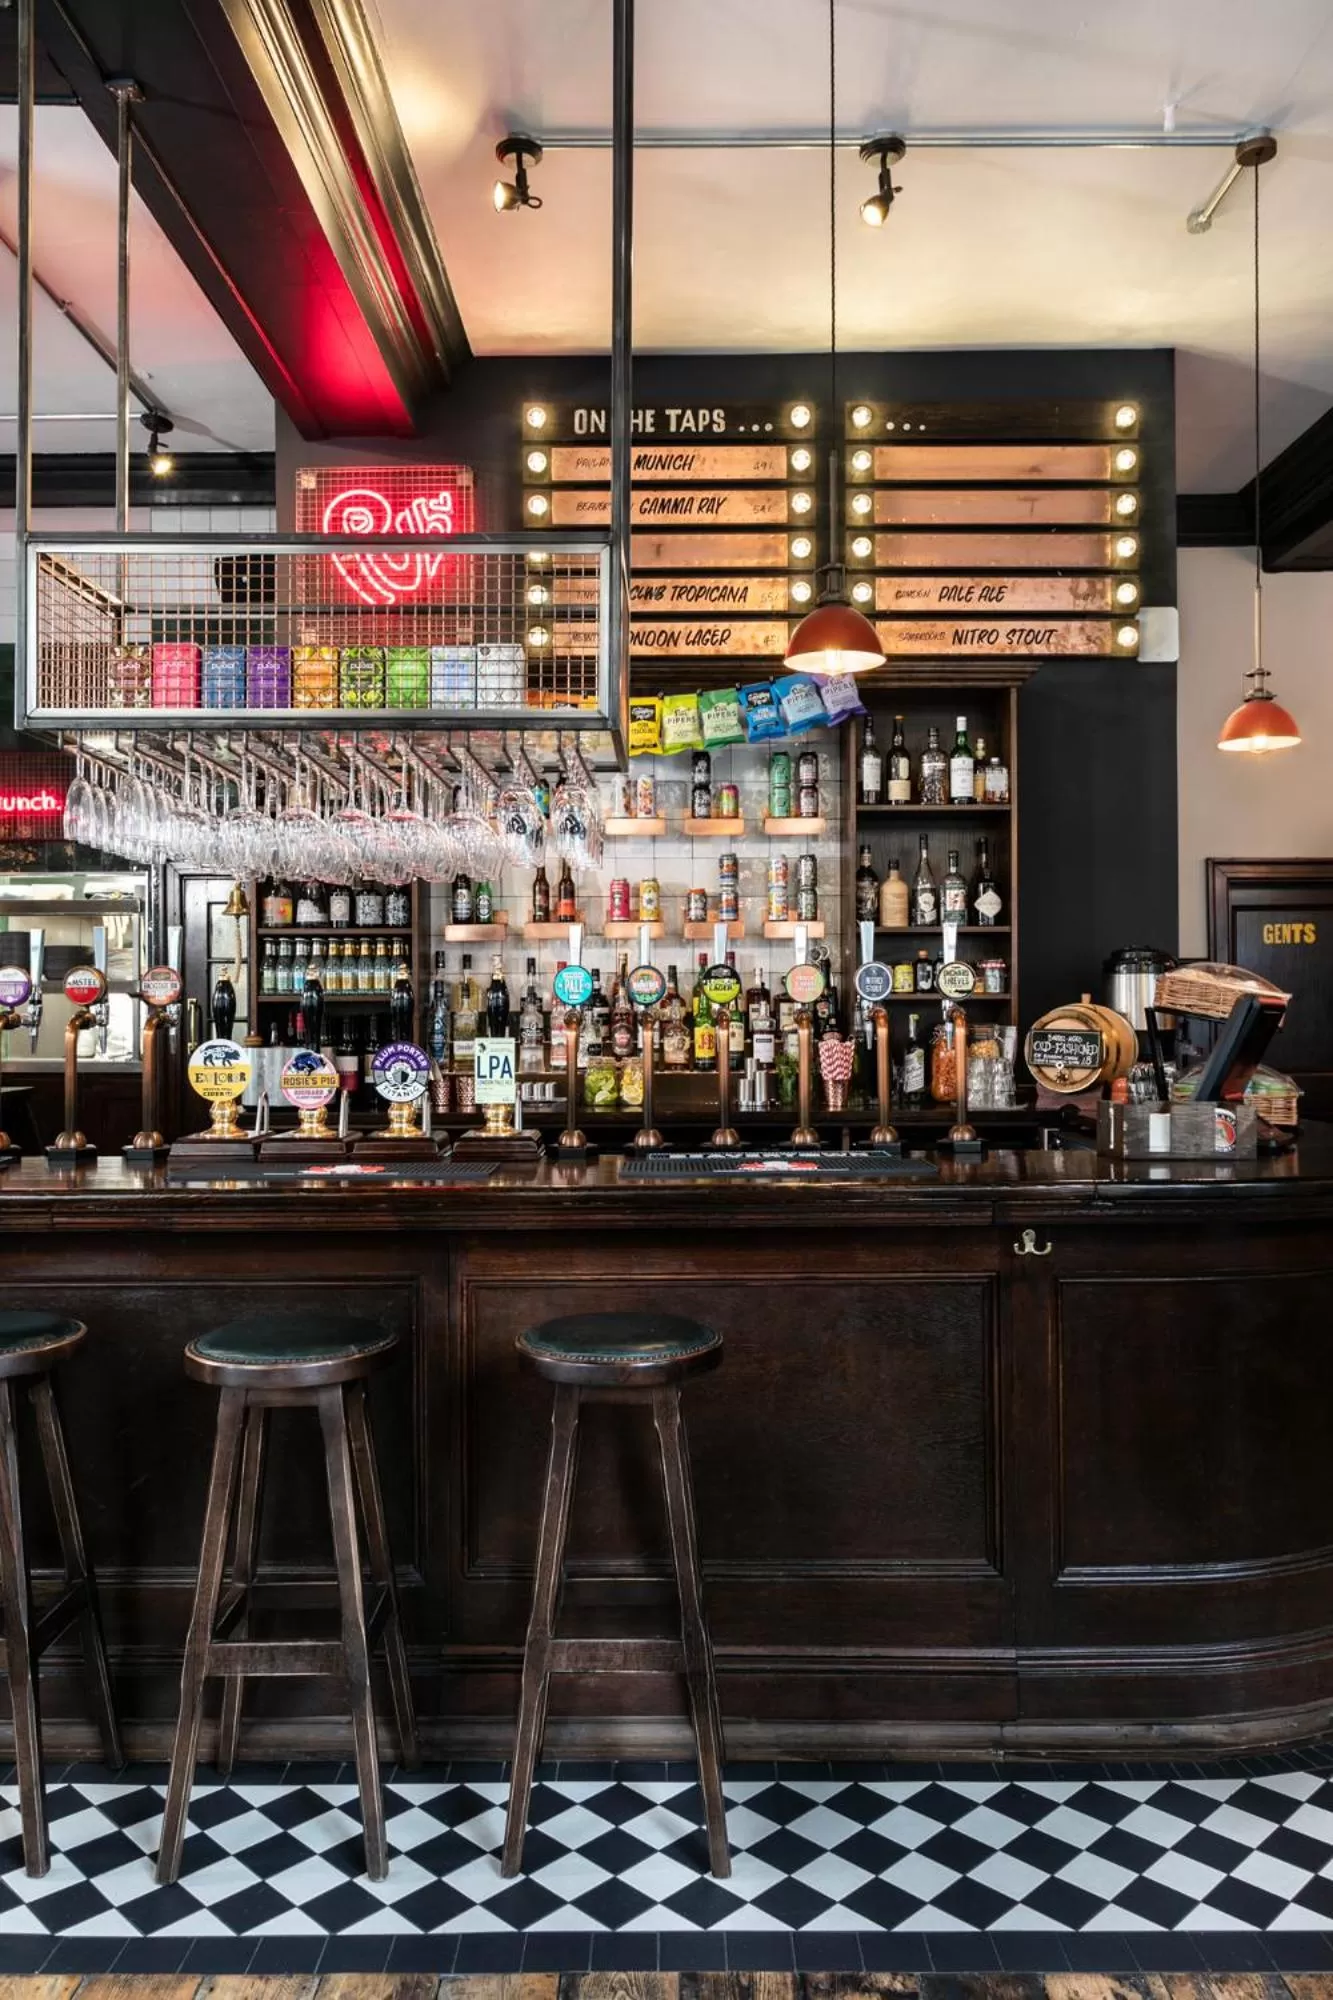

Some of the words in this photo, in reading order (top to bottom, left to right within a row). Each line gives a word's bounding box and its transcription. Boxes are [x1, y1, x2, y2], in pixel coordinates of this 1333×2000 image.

[574, 408, 606, 435] ON
[664, 408, 727, 433] TAPS
[633, 453, 697, 472] MUNICH
[639, 496, 696, 515] GAMMA
[696, 496, 728, 515] RAY
[671, 585, 750, 604] TROPICANA
[938, 585, 976, 603] PALE
[977, 585, 1008, 603] ALE
[684, 629, 732, 647] LAGER
[951, 628, 1000, 646] NITRO
[1005, 628, 1058, 646] STOUT
[667, 715, 697, 725] PIPERS
[707, 709, 737, 721] PIPERS
[0, 789, 61, 811] unch.
[1263, 923, 1317, 945] GENTS
[564, 978, 585, 993] PALE
[374, 1045, 397, 1068] PLUM
[397, 1044, 428, 1067] PORTER
[476, 1055, 513, 1079] LPA
[283, 1076, 318, 1087] ROSIE'S
[320, 1076, 336, 1086] PIG
[382, 1084, 421, 1097] TITANIC
